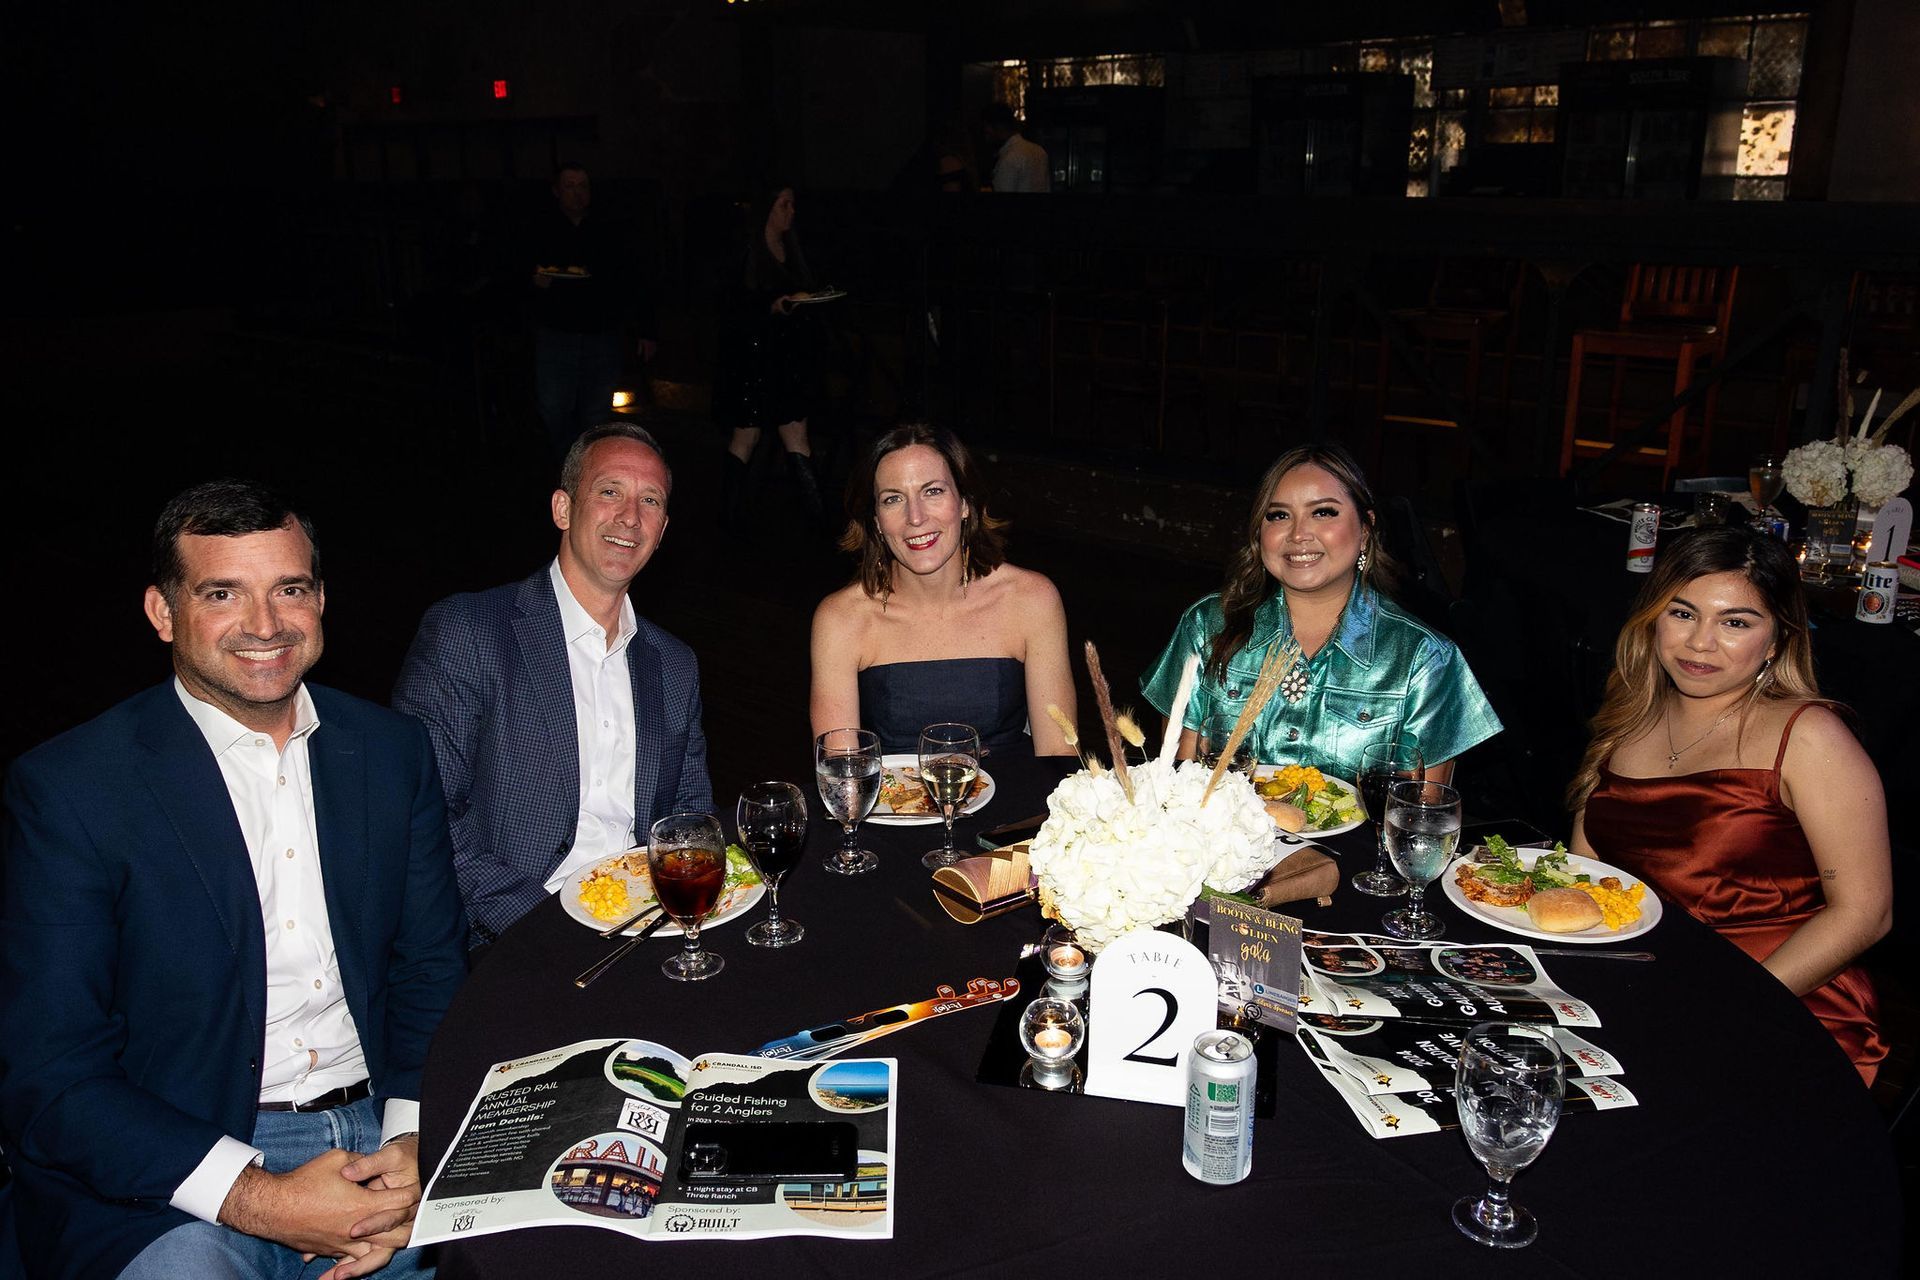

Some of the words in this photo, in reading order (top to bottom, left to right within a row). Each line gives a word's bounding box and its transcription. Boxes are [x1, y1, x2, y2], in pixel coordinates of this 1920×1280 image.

[1886, 525, 1896, 562] 1
[1217, 904, 1251, 921] BOOTS
[1254, 915, 1262, 924] &
[1265, 918, 1299, 935] BLING
[1128, 951, 1183, 968] TABLE
[1240, 941, 1272, 963] gala
[1122, 987, 1179, 1068] 2
[712, 1061, 749, 1069] CRANDALL
[1396, 1049, 1433, 1067] 2024
[484, 1086, 531, 1102] RUSTED
[534, 1081, 559, 1093] RAIL
[692, 1092, 740, 1104] Guided
[744, 1096, 787, 1108] Fishing
[1416, 1089, 1443, 1103] 20
[474, 1099, 556, 1121] MEMBERSHIP
[480, 1096, 528, 1111] ANNUAL
[691, 1103, 709, 1112] for
[712, 1104, 721, 1114] 2
[724, 1106, 773, 1117] Anglers
[470, 1121, 495, 1131] Item
[498, 1114, 545, 1125] Details:
[566, 1139, 664, 1178] RAIL
[434, 1196, 488, 1211] Sponsored
[490, 1195, 505, 1204] by:
[667, 1205, 723, 1214] Sponsored
[726, 1207, 741, 1215] by:
[698, 1218, 741, 1228] BUILT
